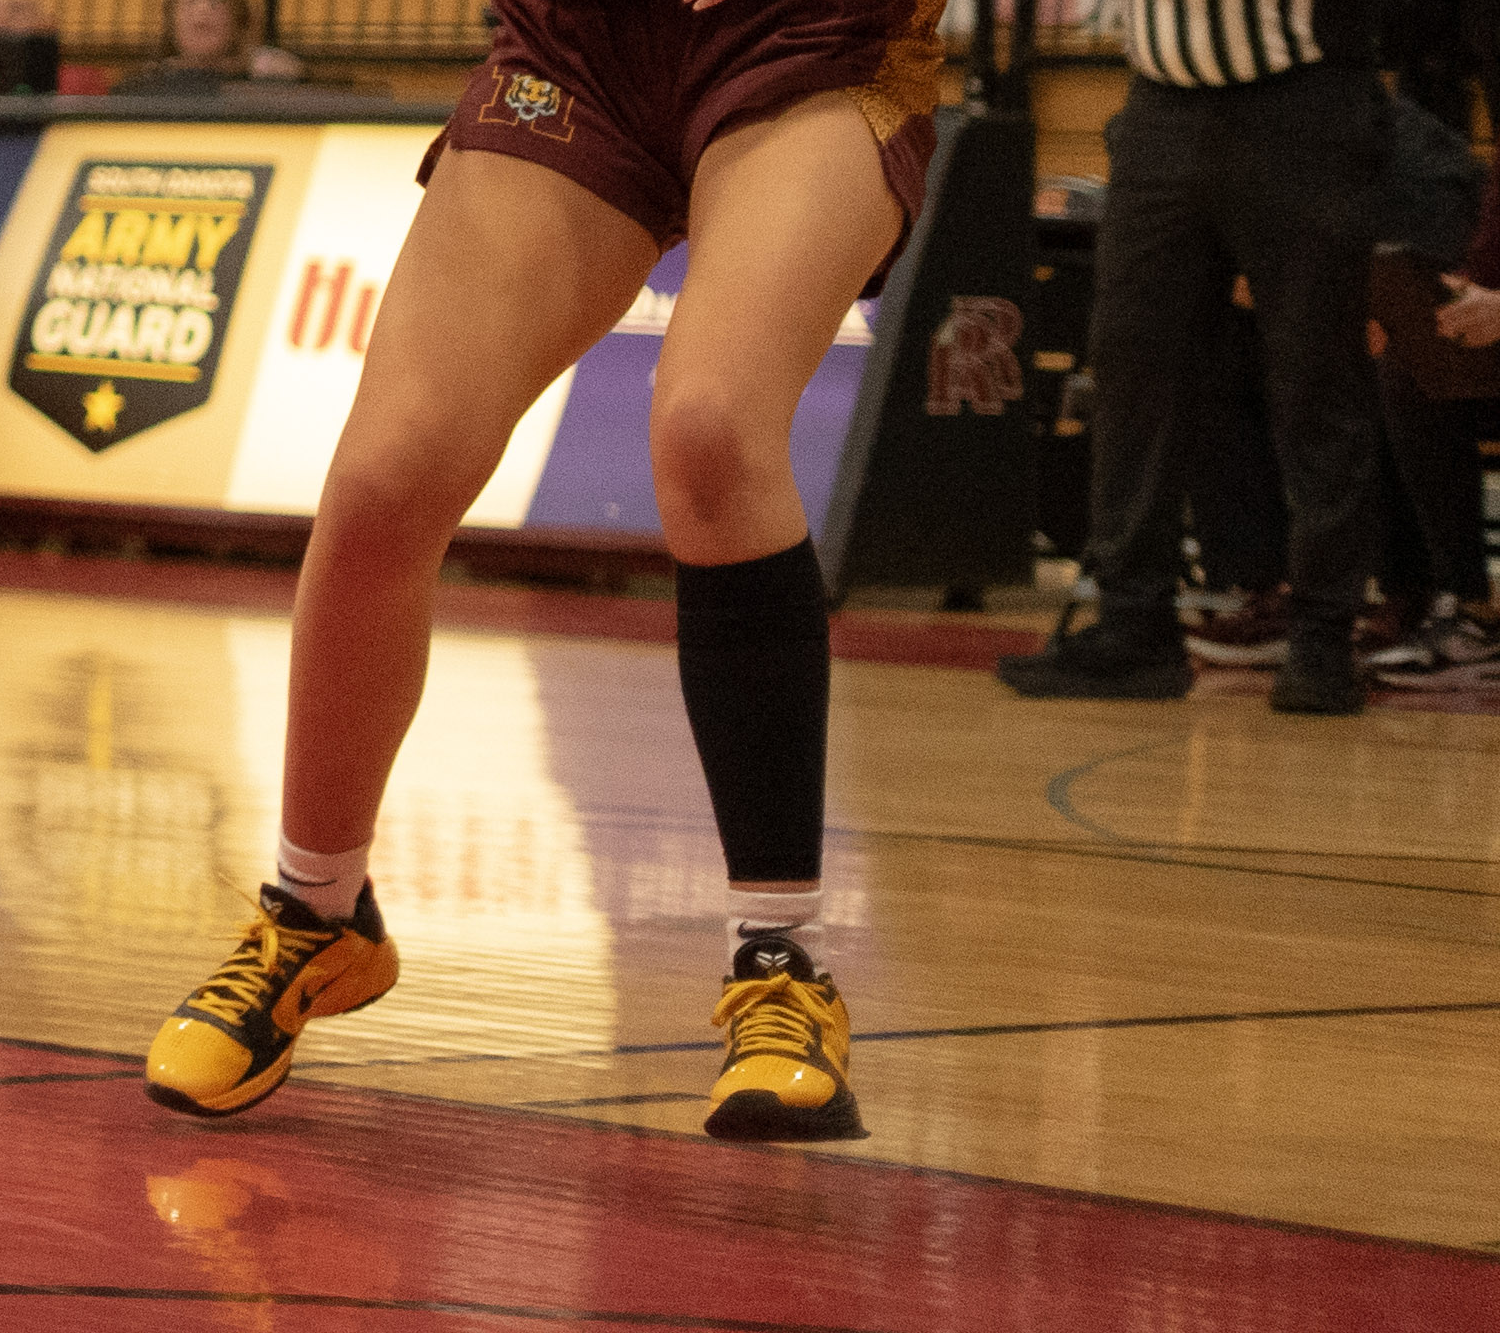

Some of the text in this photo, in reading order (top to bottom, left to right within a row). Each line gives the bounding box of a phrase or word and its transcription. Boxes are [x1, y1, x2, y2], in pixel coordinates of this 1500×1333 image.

[59, 208, 242, 270] ARMY
[46, 263, 220, 313] NATIONAL
[31, 298, 214, 366] GUARD
